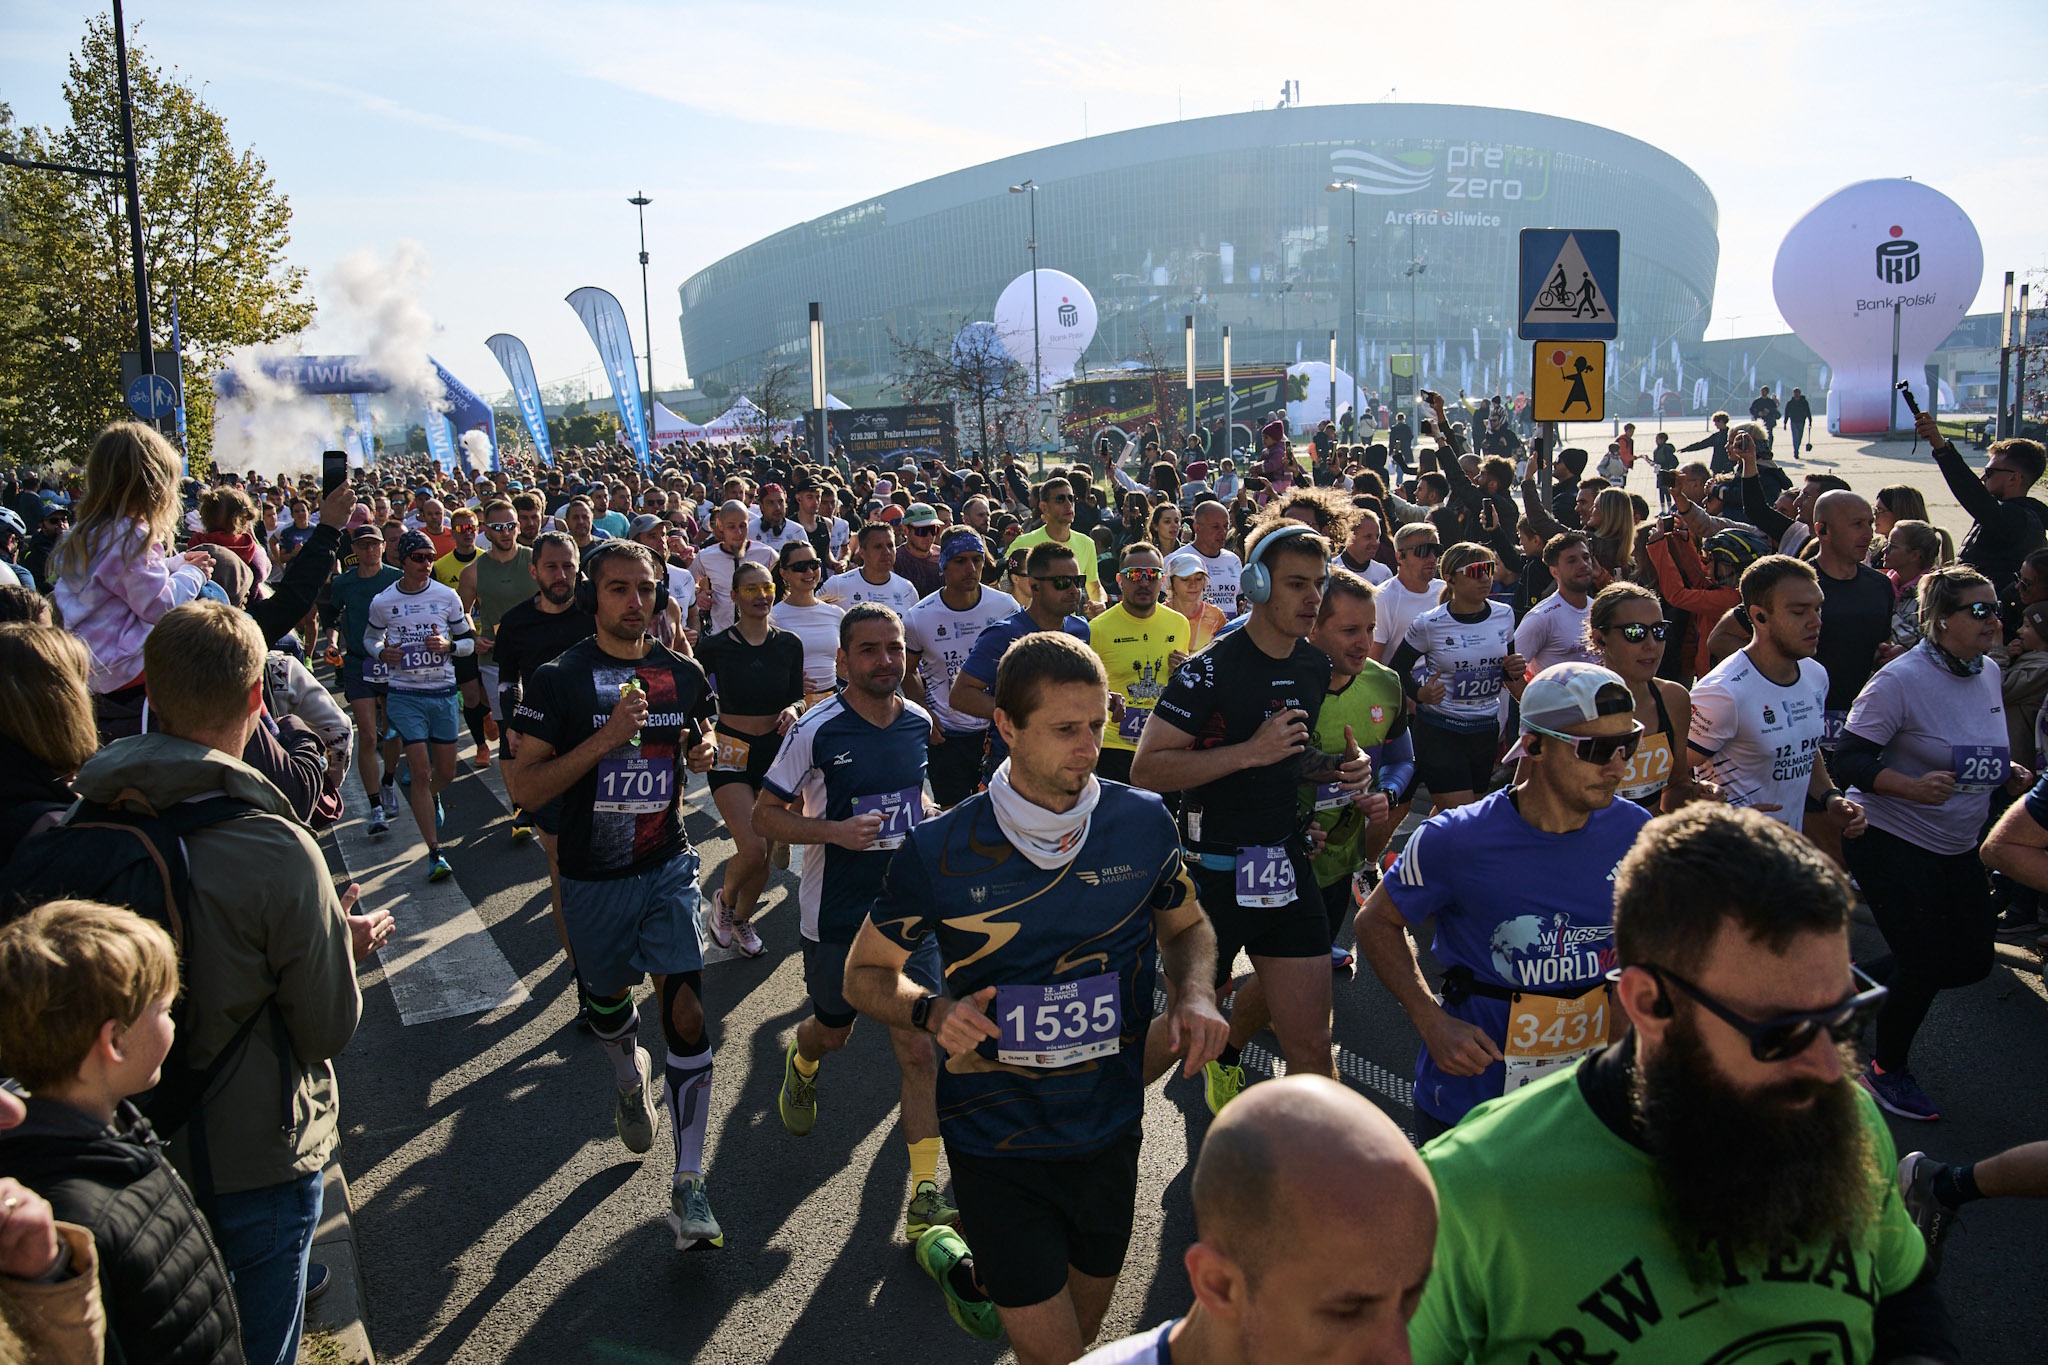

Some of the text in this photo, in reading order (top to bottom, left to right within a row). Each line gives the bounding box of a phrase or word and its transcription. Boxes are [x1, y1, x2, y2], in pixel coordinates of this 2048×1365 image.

[1447, 146, 1503, 173] pre
[1446, 177, 1522, 200] zero
[1384, 210, 1501, 227] Arena Gliwice
[1876, 240, 1921, 284] PKO
[1857, 292, 1937, 311] Bank Polski
[1954, 321, 1977, 331] WICE
[438, 369, 475, 402] GLIWICKI
[656, 430, 701, 440] MEDYCZNY
[1219, 584, 1236, 592] PKO
[403, 651, 442, 667] 1306
[1454, 661, 1473, 669] 12.
[1458, 676, 1502, 697] 1205
[1160, 700, 1192, 719] BOXING
[1776, 744, 1796, 758] 12.
[1961, 757, 2002, 780] 263
[603, 770, 667, 796] 1701
[1101, 864, 1133, 876] SILESIA
[1102, 869, 1148, 885] MARATHON
[1241, 859, 1295, 889] 1450
[1541, 926, 1598, 946] WINGS
[1538, 944, 1552, 953] FOR
[1518, 950, 1600, 986] WORLD
[1044, 982, 1078, 994] 12. PKO
[1044, 992, 1078, 1002] GLIWICKI
[1006, 994, 1116, 1042] 1535
[1513, 1005, 1604, 1048] 3431
